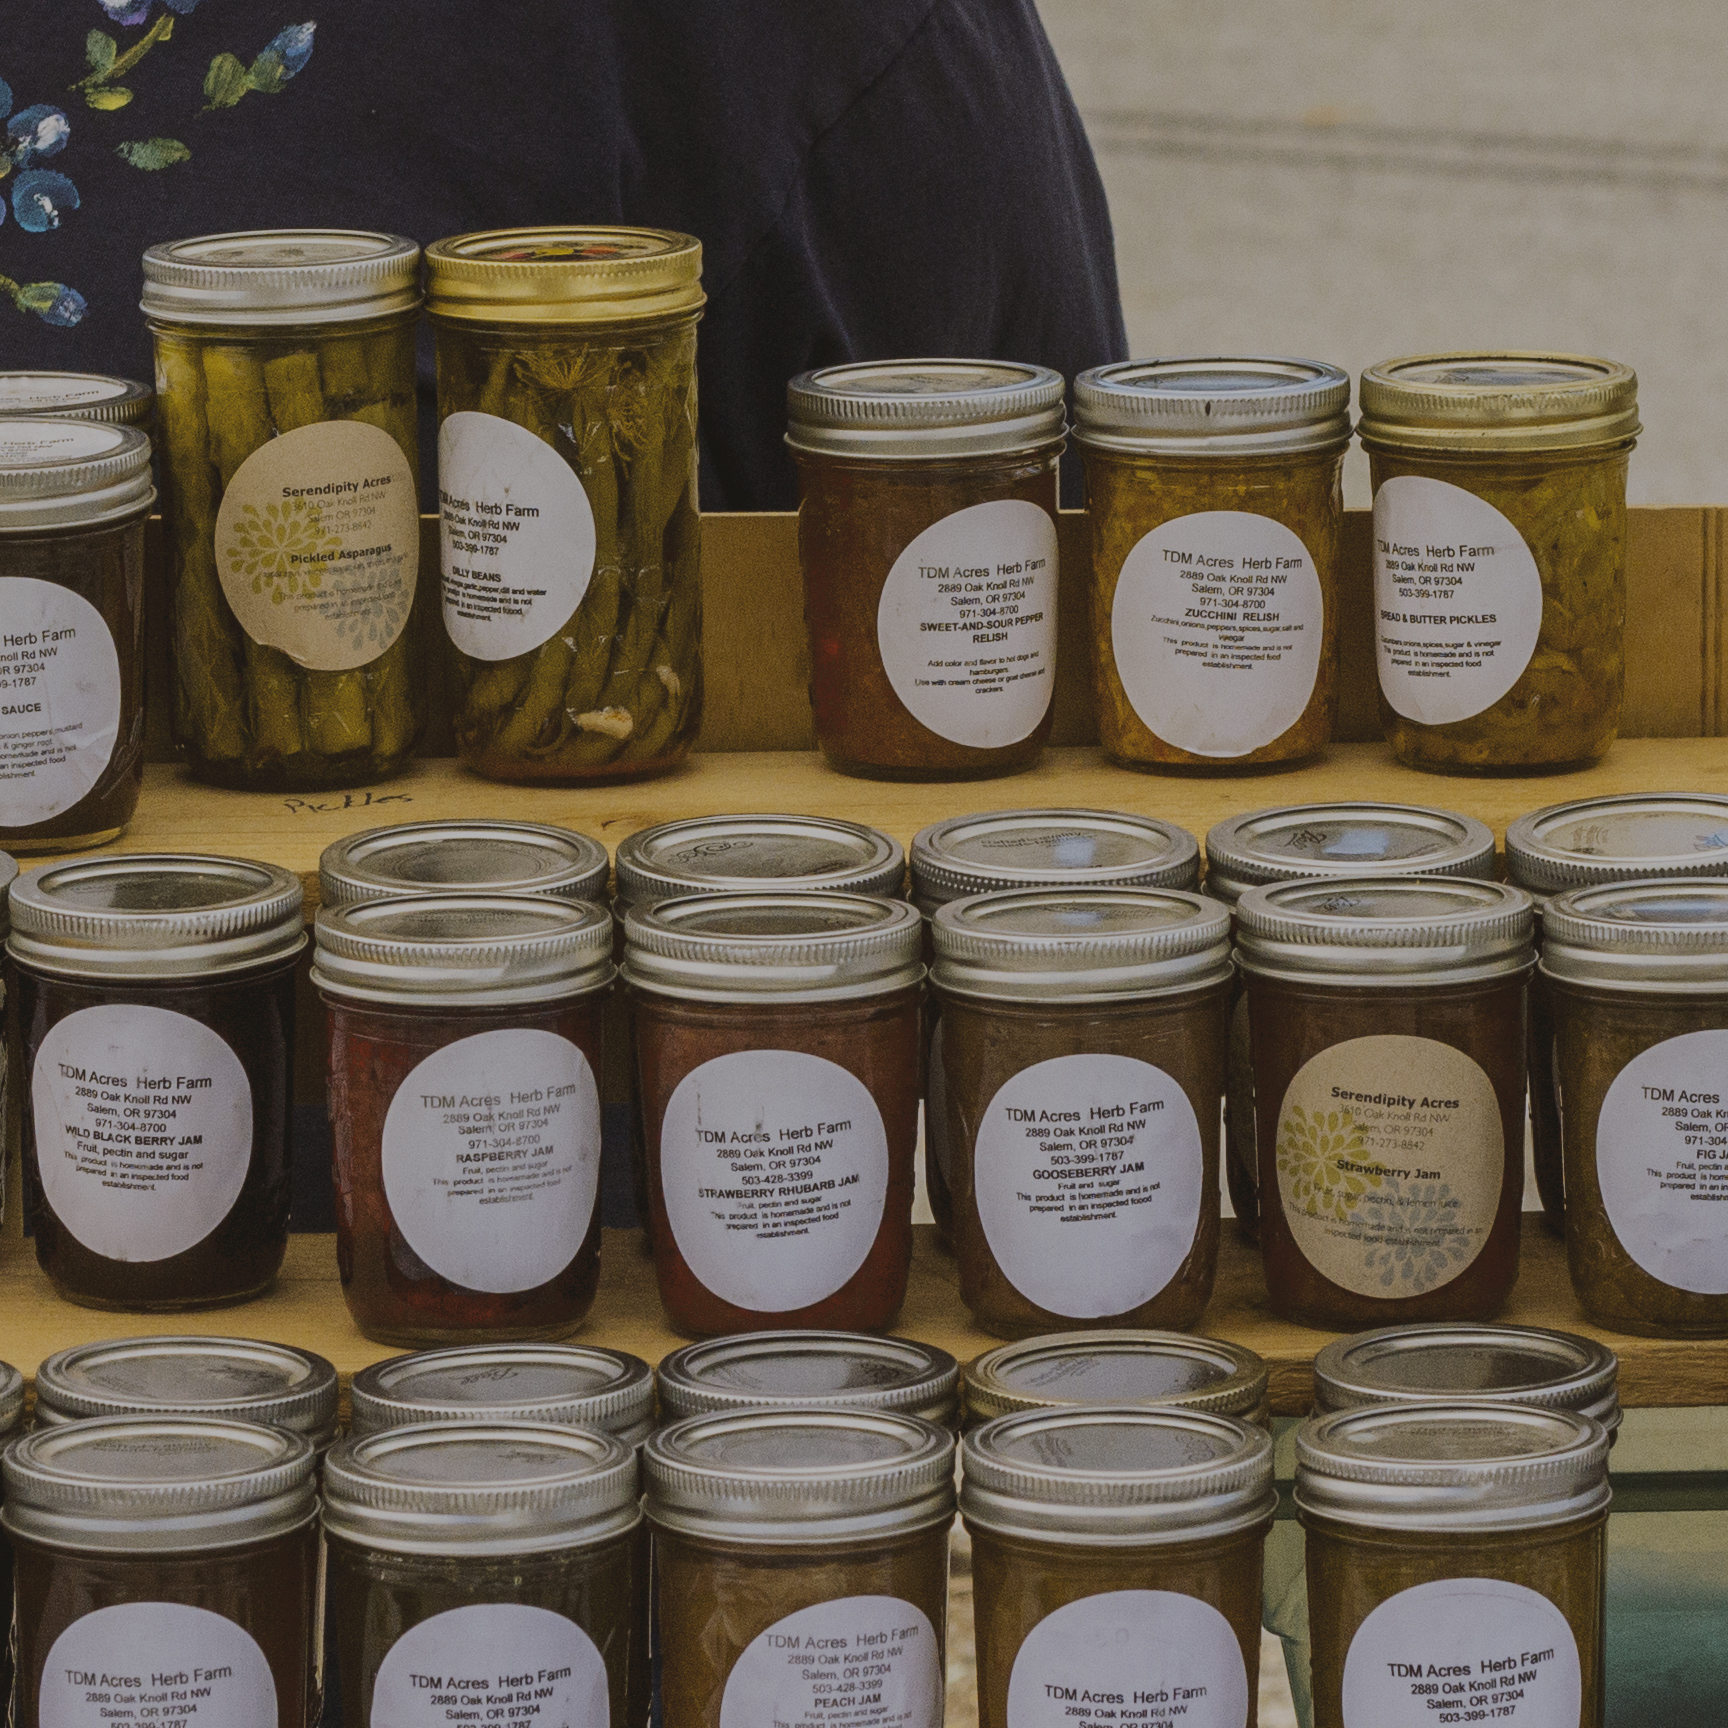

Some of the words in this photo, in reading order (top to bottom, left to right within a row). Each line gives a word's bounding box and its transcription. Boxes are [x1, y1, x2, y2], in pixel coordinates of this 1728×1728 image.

[282, 481, 359, 498] Serendipity
[362, 475, 391, 489] Acres
[476, 501, 502, 516] Herb
[505, 504, 539, 517] Farm
[291, 551, 335, 564] Pickled
[338, 544, 392, 560] Asparagus
[1392, 543, 1420, 557] Acres
[1426, 545, 1455, 558] Herb
[1459, 545, 1494, 557] Farm
[471, 570, 502, 583] BEANS
[920, 618, 1014, 632] SWEET-AND-SOUR
[1015, 612, 1044, 626] PEPPER
[1185, 608, 1237, 621] ZUCCHINI
[1242, 612, 1280, 622] RELISH
[1402, 614, 1408, 623] &
[1409, 615, 1447, 625] BUTTER
[1449, 614, 1497, 625] PICKLES
[3, 632, 38, 648] Herb
[42, 627, 76, 643] Farm
[972, 632, 1008, 644] RELISH
[1, 702, 42, 716] SAUCE
[1331, 1086, 1416, 1109] Serendipity
[1420, 1097, 1460, 1109] Acres
[1005, 1108, 1035, 1122] TDM
[1039, 1110, 1081, 1122] Acres
[1090, 1105, 1126, 1120] Herb
[1129, 1100, 1165, 1115] Farm
[65, 1125, 90, 1138] WILD
[93, 1131, 132, 1144] BLACK
[134, 1136, 176, 1146] BERRY
[178, 1135, 203, 1146] JAM
[456, 1150, 528, 1163] RASPBERRY
[531, 1145, 554, 1157] JAM
[1696, 1149, 1717, 1160] FIG
[1033, 1166, 1117, 1180] GOOSEBERRY
[1119, 1162, 1145, 1173] JAM
[1336, 1159, 1411, 1180] Strawberry
[1414, 1168, 1441, 1180] Jam
[698, 1188, 775, 1198] STRAWBERRY
[778, 1179, 836, 1197] RHUBARB
[838, 1173, 860, 1187] JAM
[1388, 1663, 1423, 1678] TDM
[1426, 1664, 1472, 1678] Acres
[1481, 1657, 1517, 1674] Herb
[1521, 1649, 1554, 1667] Farm
[814, 1697, 856, 1709] PEACH
[858, 1693, 881, 1705] JAM
[100, 1707, 137, 1719] Salem,
[140, 1708, 159, 1717] OR
[162, 1704, 197, 1716] 97304
[1439, 1705, 1517, 1724] 503-399-1787
